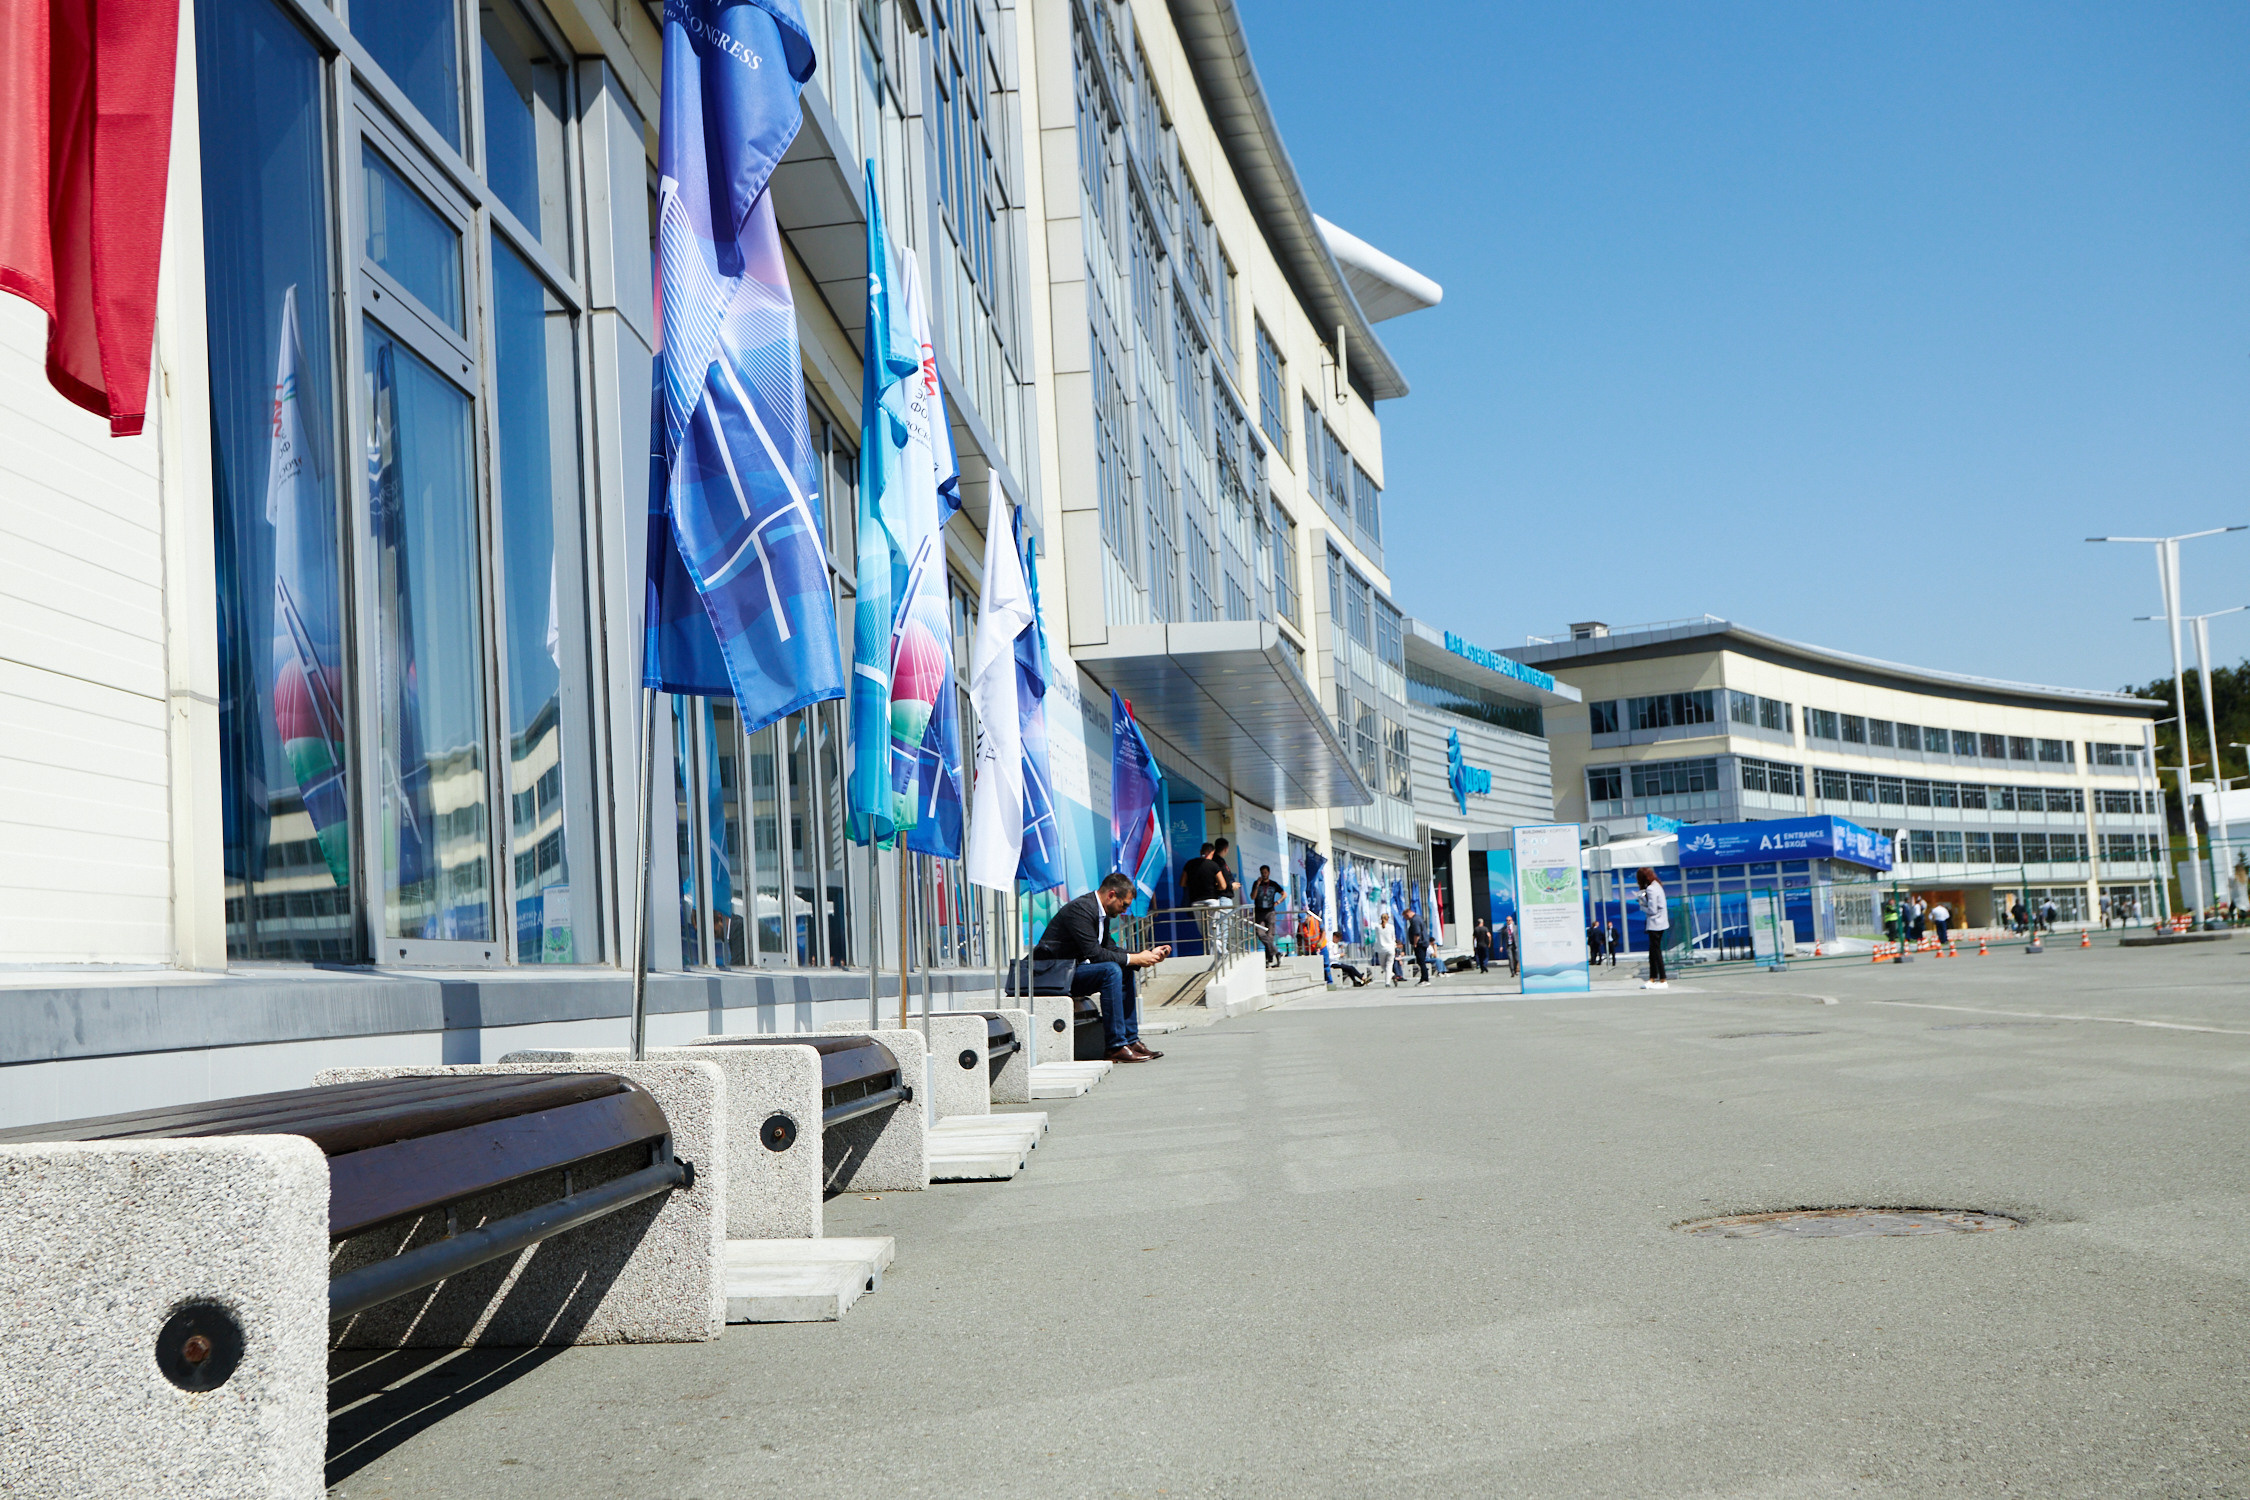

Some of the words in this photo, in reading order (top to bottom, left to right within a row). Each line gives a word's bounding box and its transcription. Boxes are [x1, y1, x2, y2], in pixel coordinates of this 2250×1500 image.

[1759, 833, 1783, 850] A1
[1783, 830, 1824, 840] ENTRANCE
[1784, 840, 1808, 848] ВХОД
